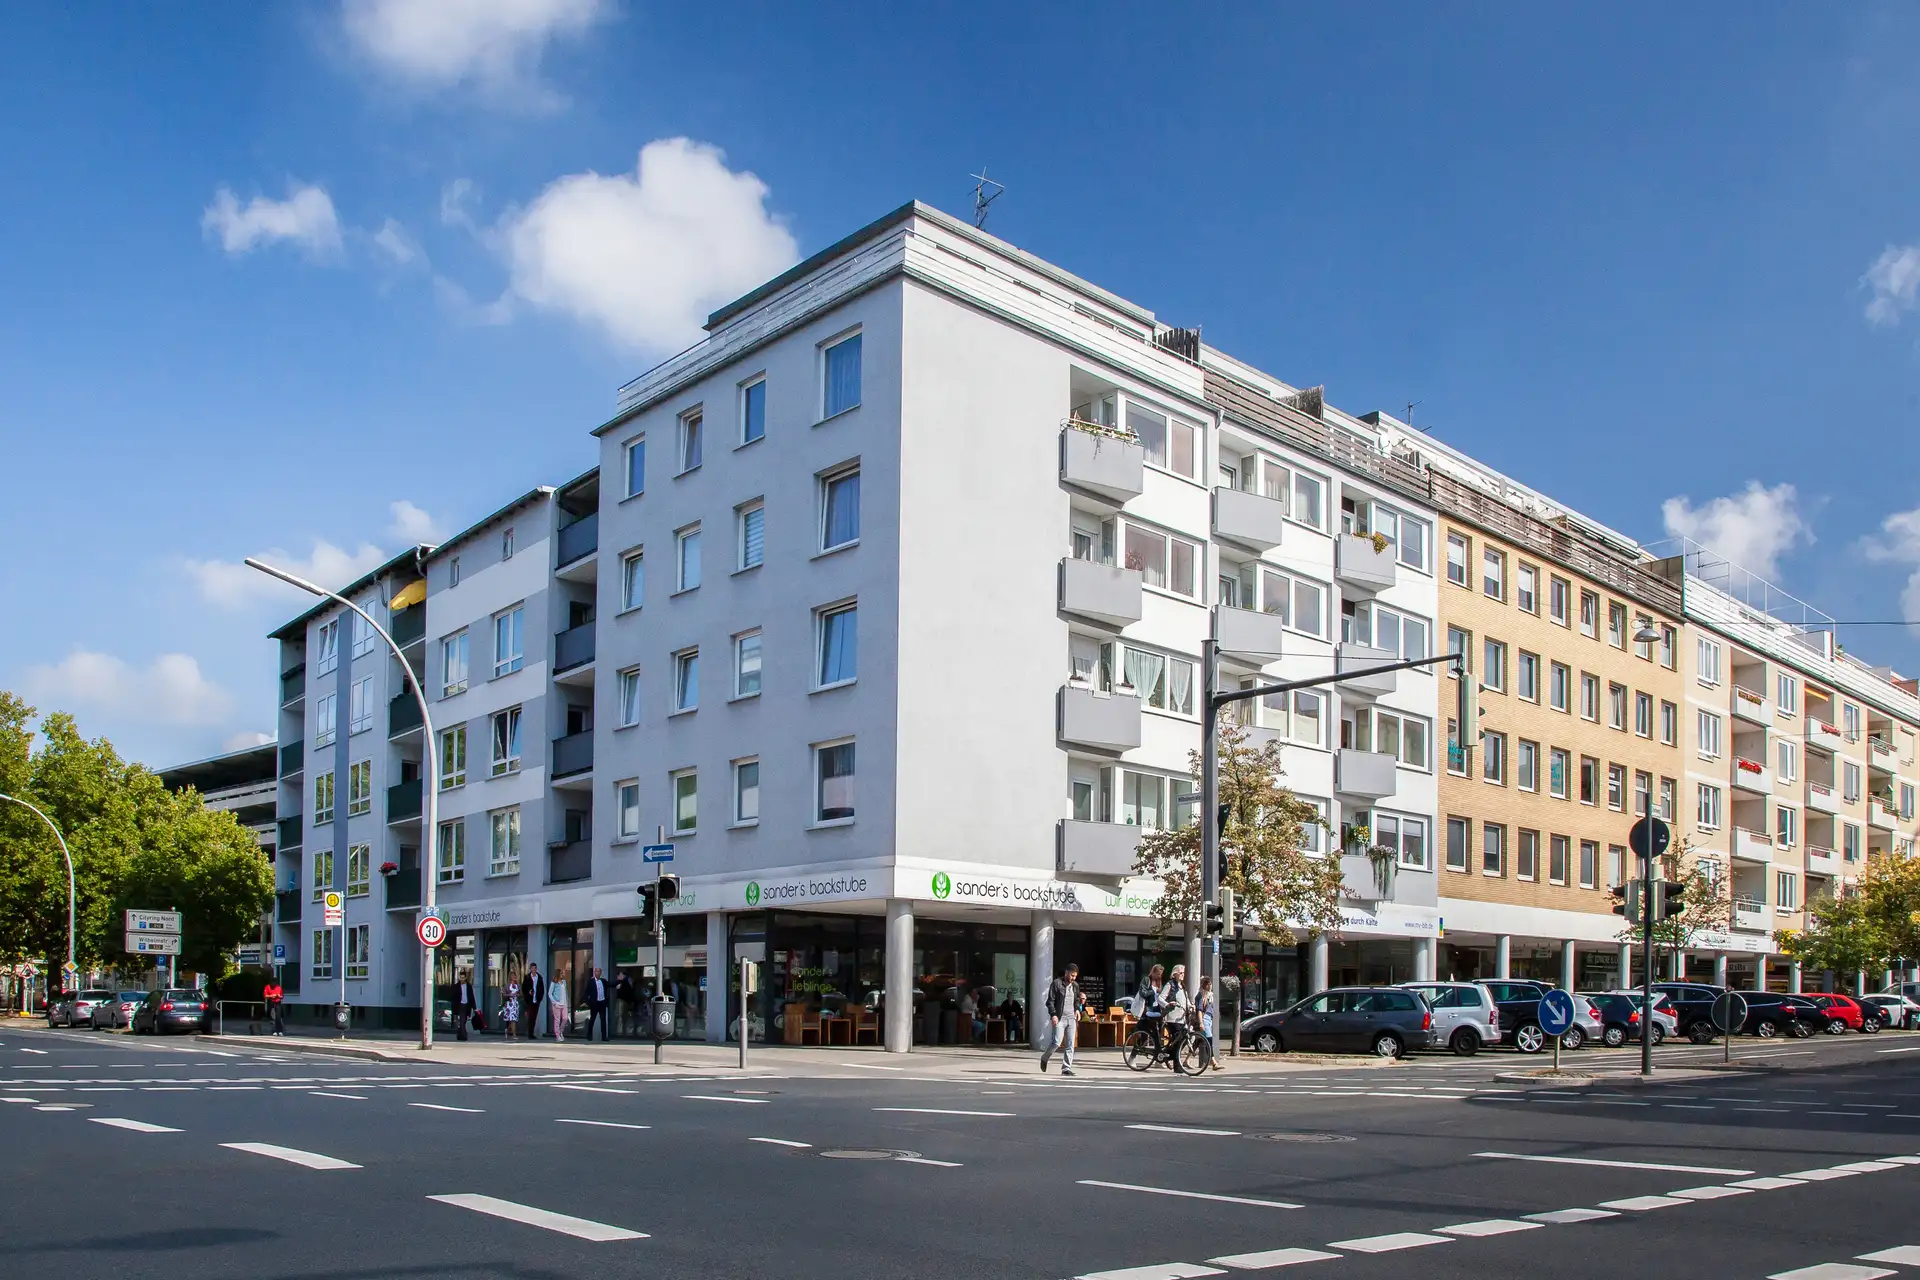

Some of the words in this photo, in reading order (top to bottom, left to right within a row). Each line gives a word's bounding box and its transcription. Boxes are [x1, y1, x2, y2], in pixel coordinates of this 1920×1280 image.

[763, 882, 806, 900] sander's
[809, 876, 867, 896] backstube
[956, 880, 1009, 899] sander's
[1013, 884, 1076, 904] backstube
[472, 909, 501, 923] backstube
[425, 925, 438, 939] 30
[276, 946, 284, 957] P
[159, 956, 165, 965] P
